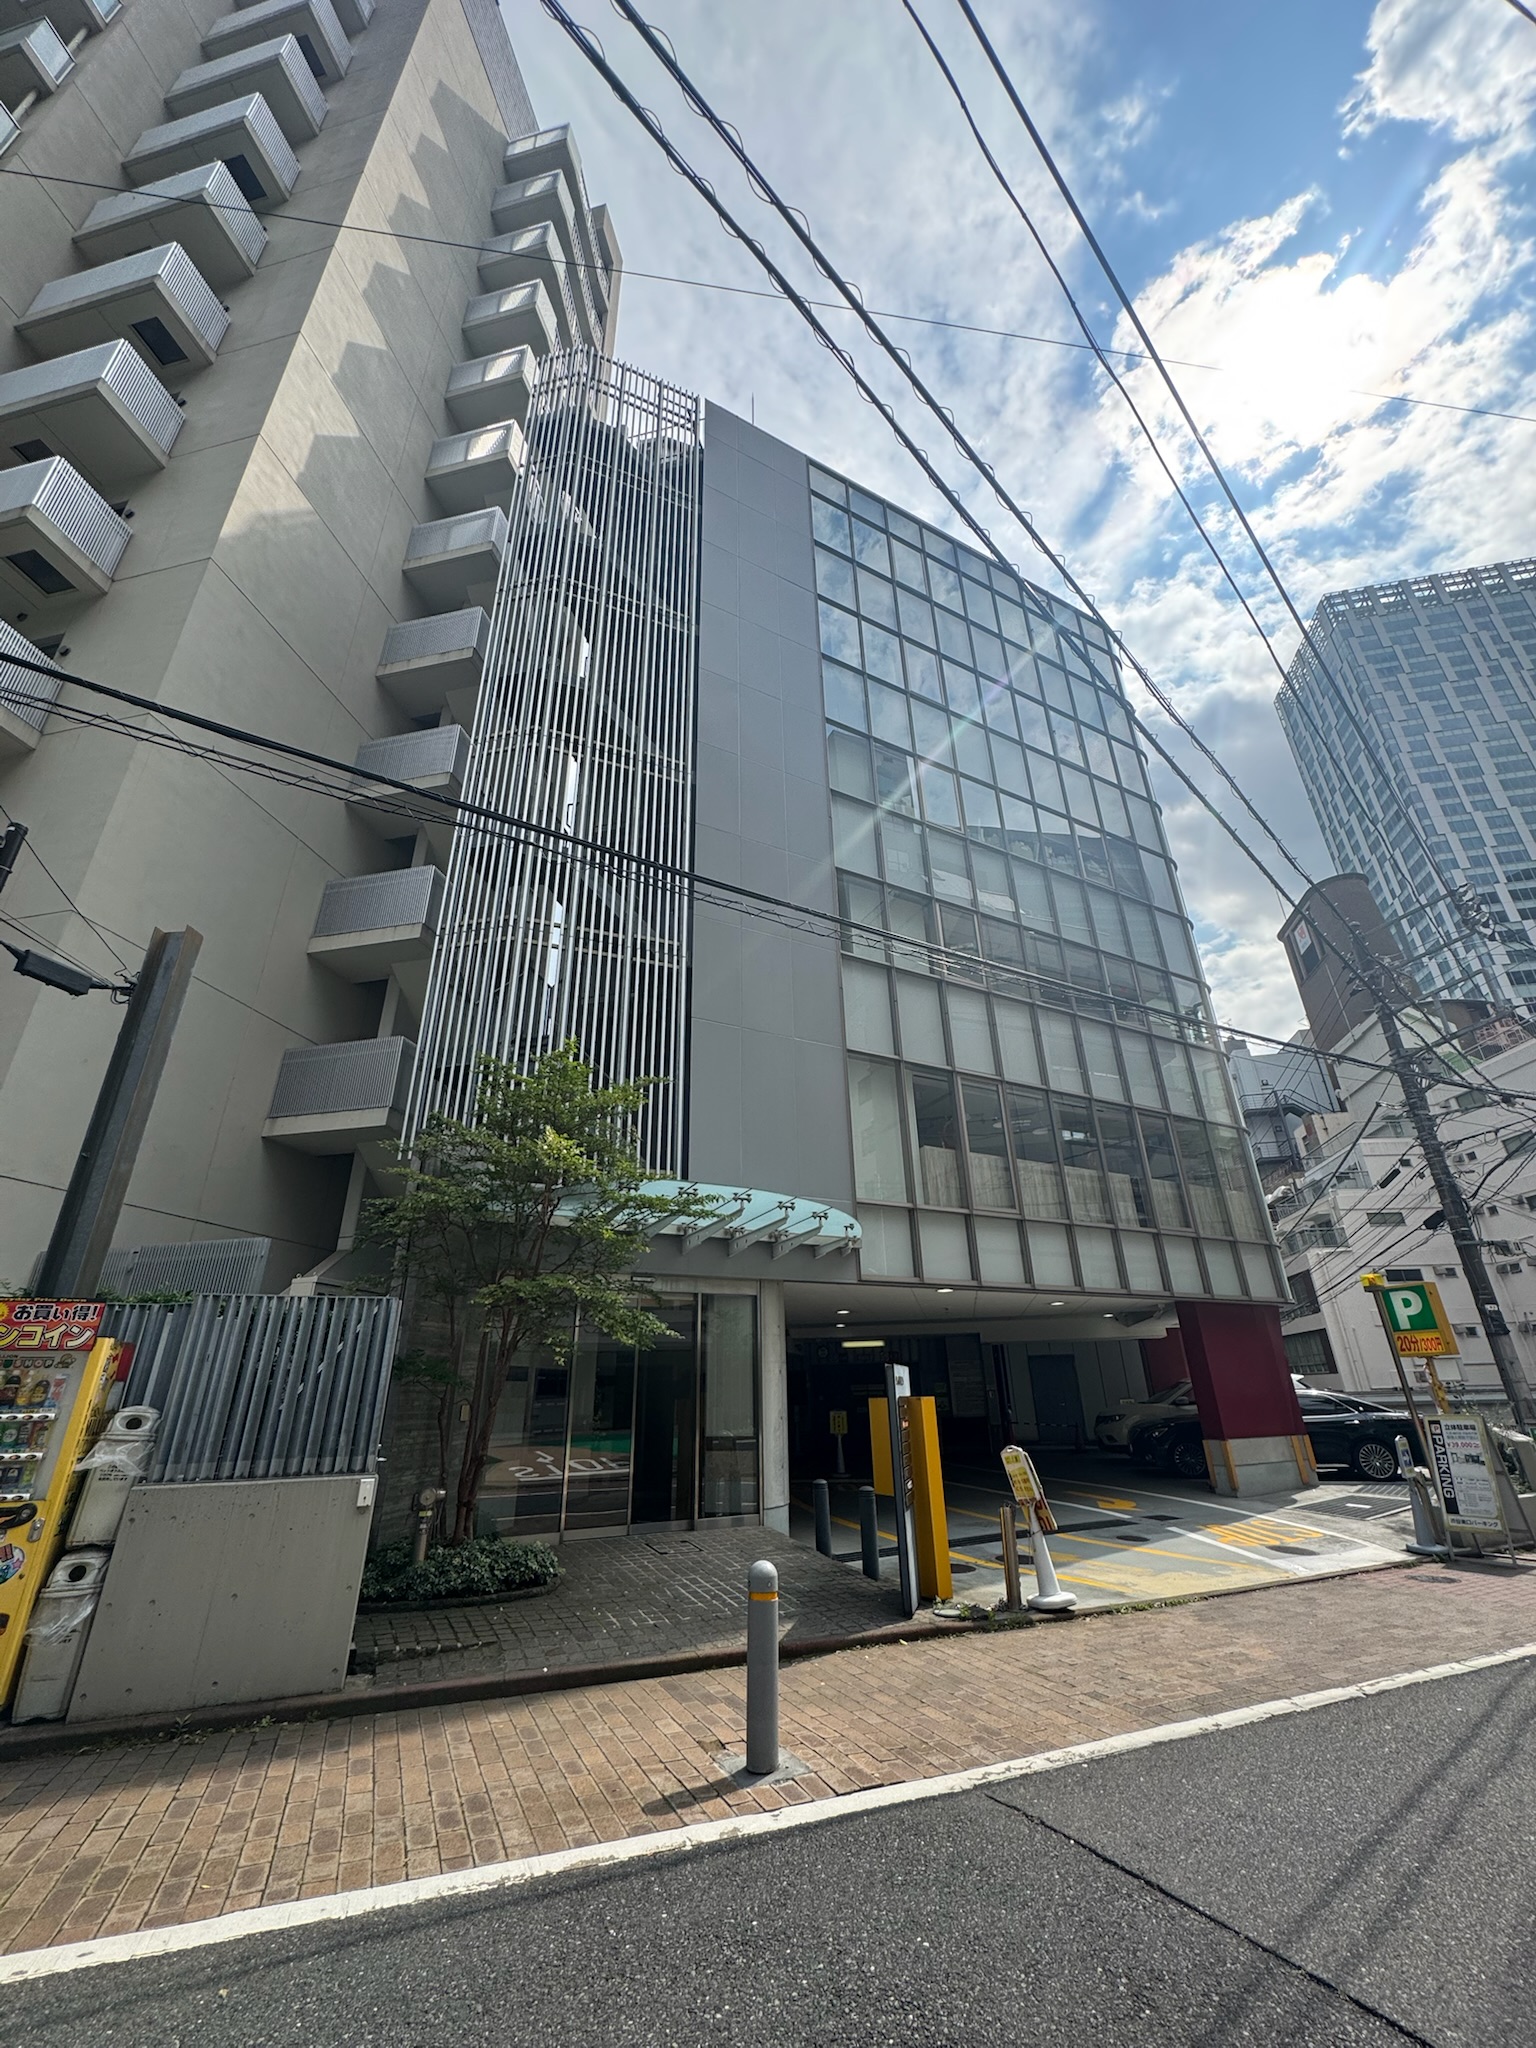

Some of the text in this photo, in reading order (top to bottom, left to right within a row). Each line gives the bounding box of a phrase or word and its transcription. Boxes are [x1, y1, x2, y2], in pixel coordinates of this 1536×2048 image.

[13, 1304, 99, 1321] お買い得!
[1388, 1290, 1423, 1330] P
[1432, 1435, 1455, 1499] PARKING
